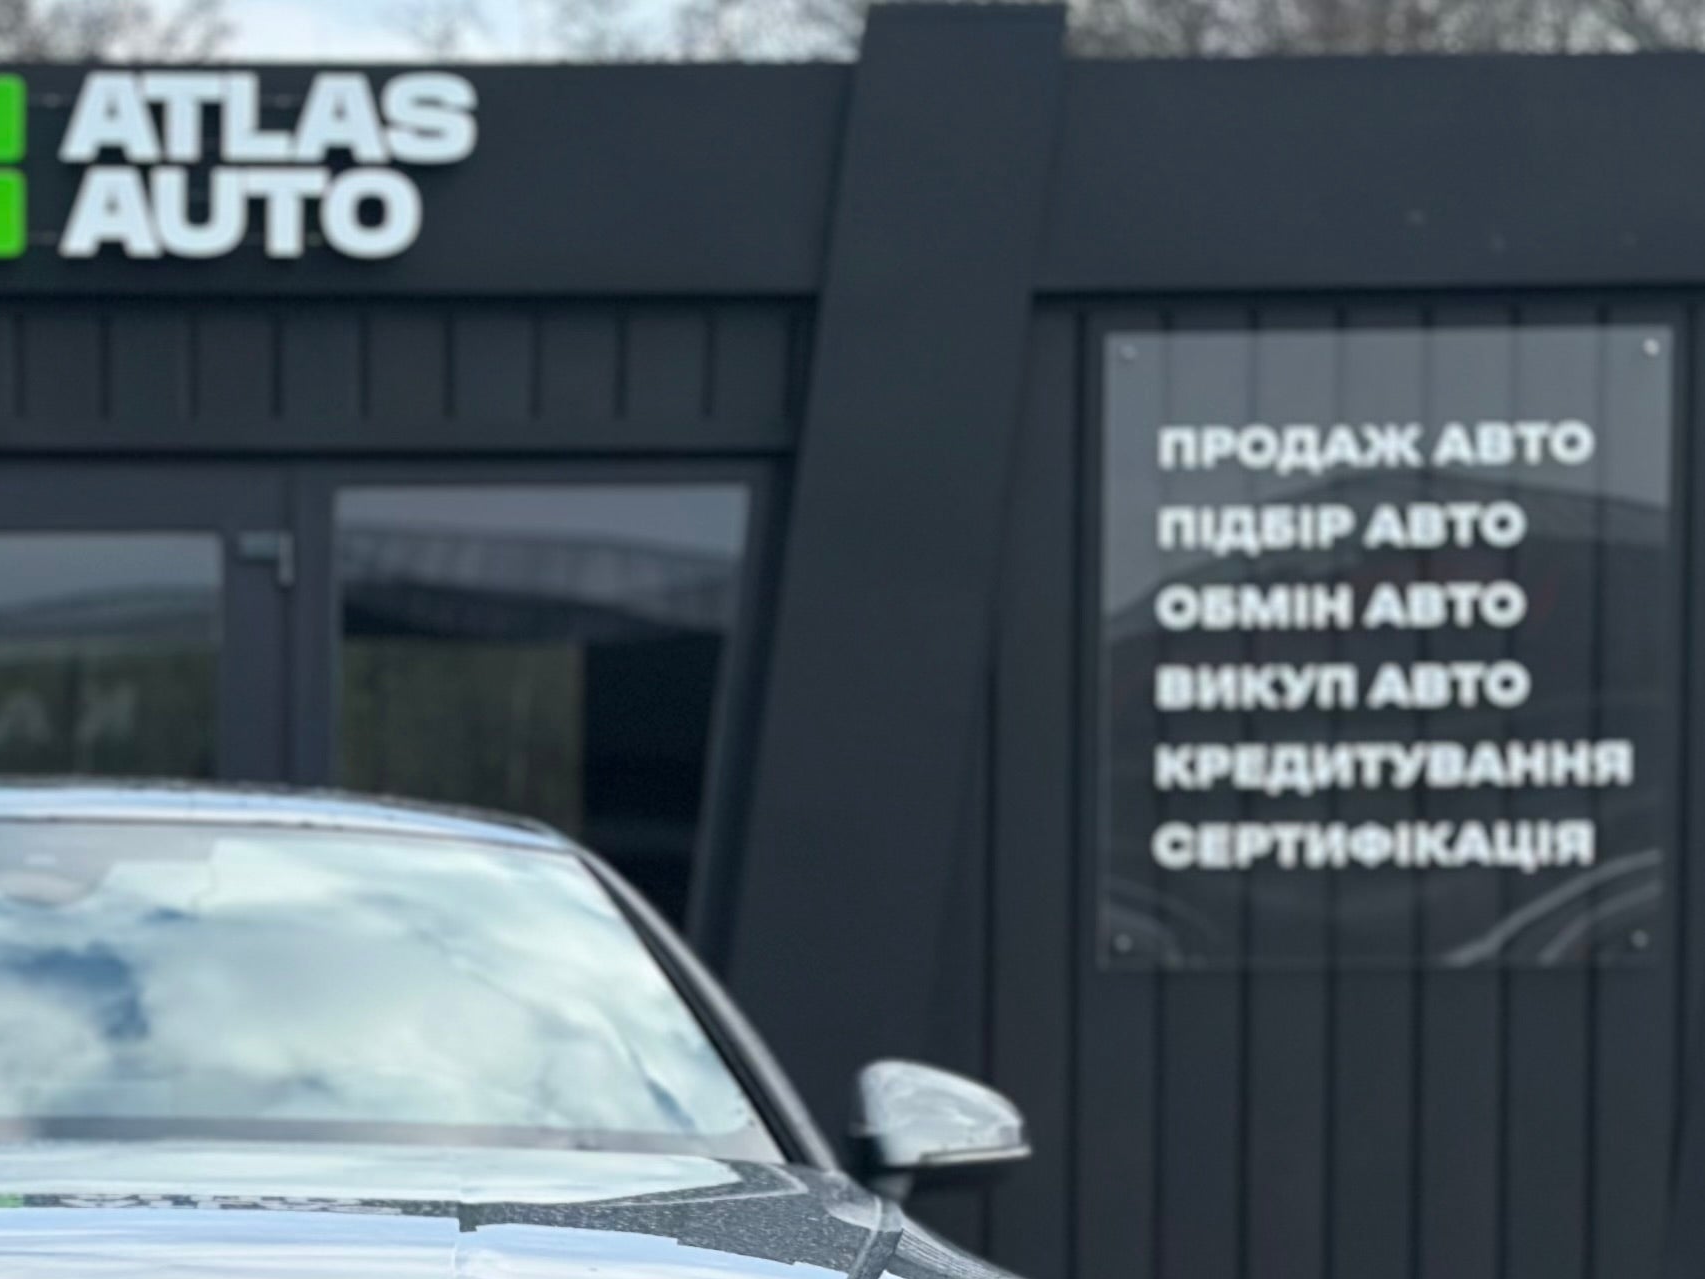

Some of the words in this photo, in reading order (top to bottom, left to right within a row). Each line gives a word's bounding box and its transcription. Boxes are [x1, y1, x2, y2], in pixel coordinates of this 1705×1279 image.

[60, 71, 479, 165] ATLAS
[60, 167, 422, 258] AUTO
[1158, 424, 1422, 474] ПРОДАЖ
[1433, 420, 1594, 465] АВТО
[1158, 505, 1355, 555] ПІДБІР
[1365, 502, 1526, 547] АВТО
[1156, 585, 1353, 629] ОБМІН
[1365, 582, 1526, 627] АВТО
[1156, 665, 1357, 709] ВИКУП
[1369, 662, 1530, 707] АВТО
[1156, 741, 1633, 794] КРЕДИТУВАННЯ
[1152, 821, 1595, 872] СЕРТИФІКАЦІЯ
